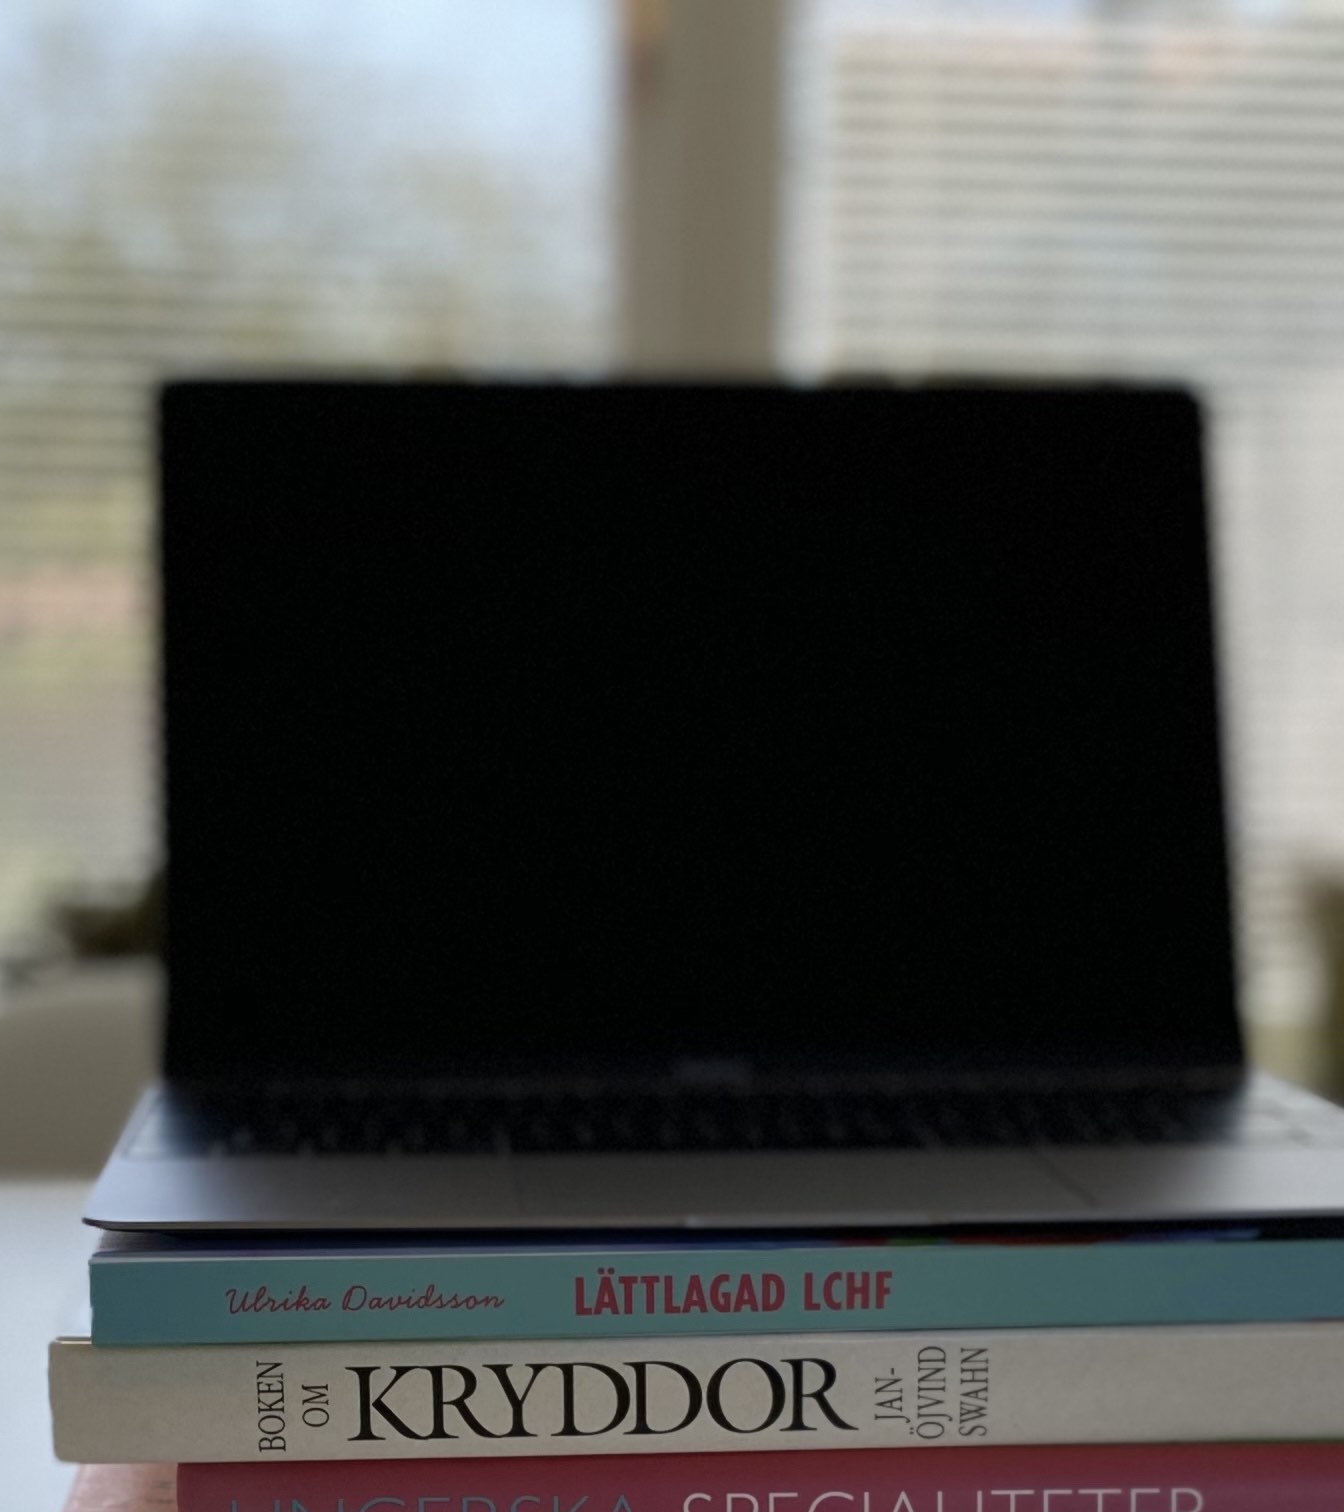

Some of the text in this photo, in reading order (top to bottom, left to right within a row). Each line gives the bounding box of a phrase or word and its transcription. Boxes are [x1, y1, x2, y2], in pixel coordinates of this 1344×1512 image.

[226, 1284, 504, 1314] Ulrika Davidsson
[575, 1268, 892, 1316] LÄTTLAGAD LCHF
[256, 1361, 286, 1452] BOKEN
[302, 1384, 329, 1427] OM
[346, 1358, 858, 1441] KRYDDOR
[909, 1346, 947, 1439] ÖJVIND
[959, 1348, 988, 1436] SWAHN
